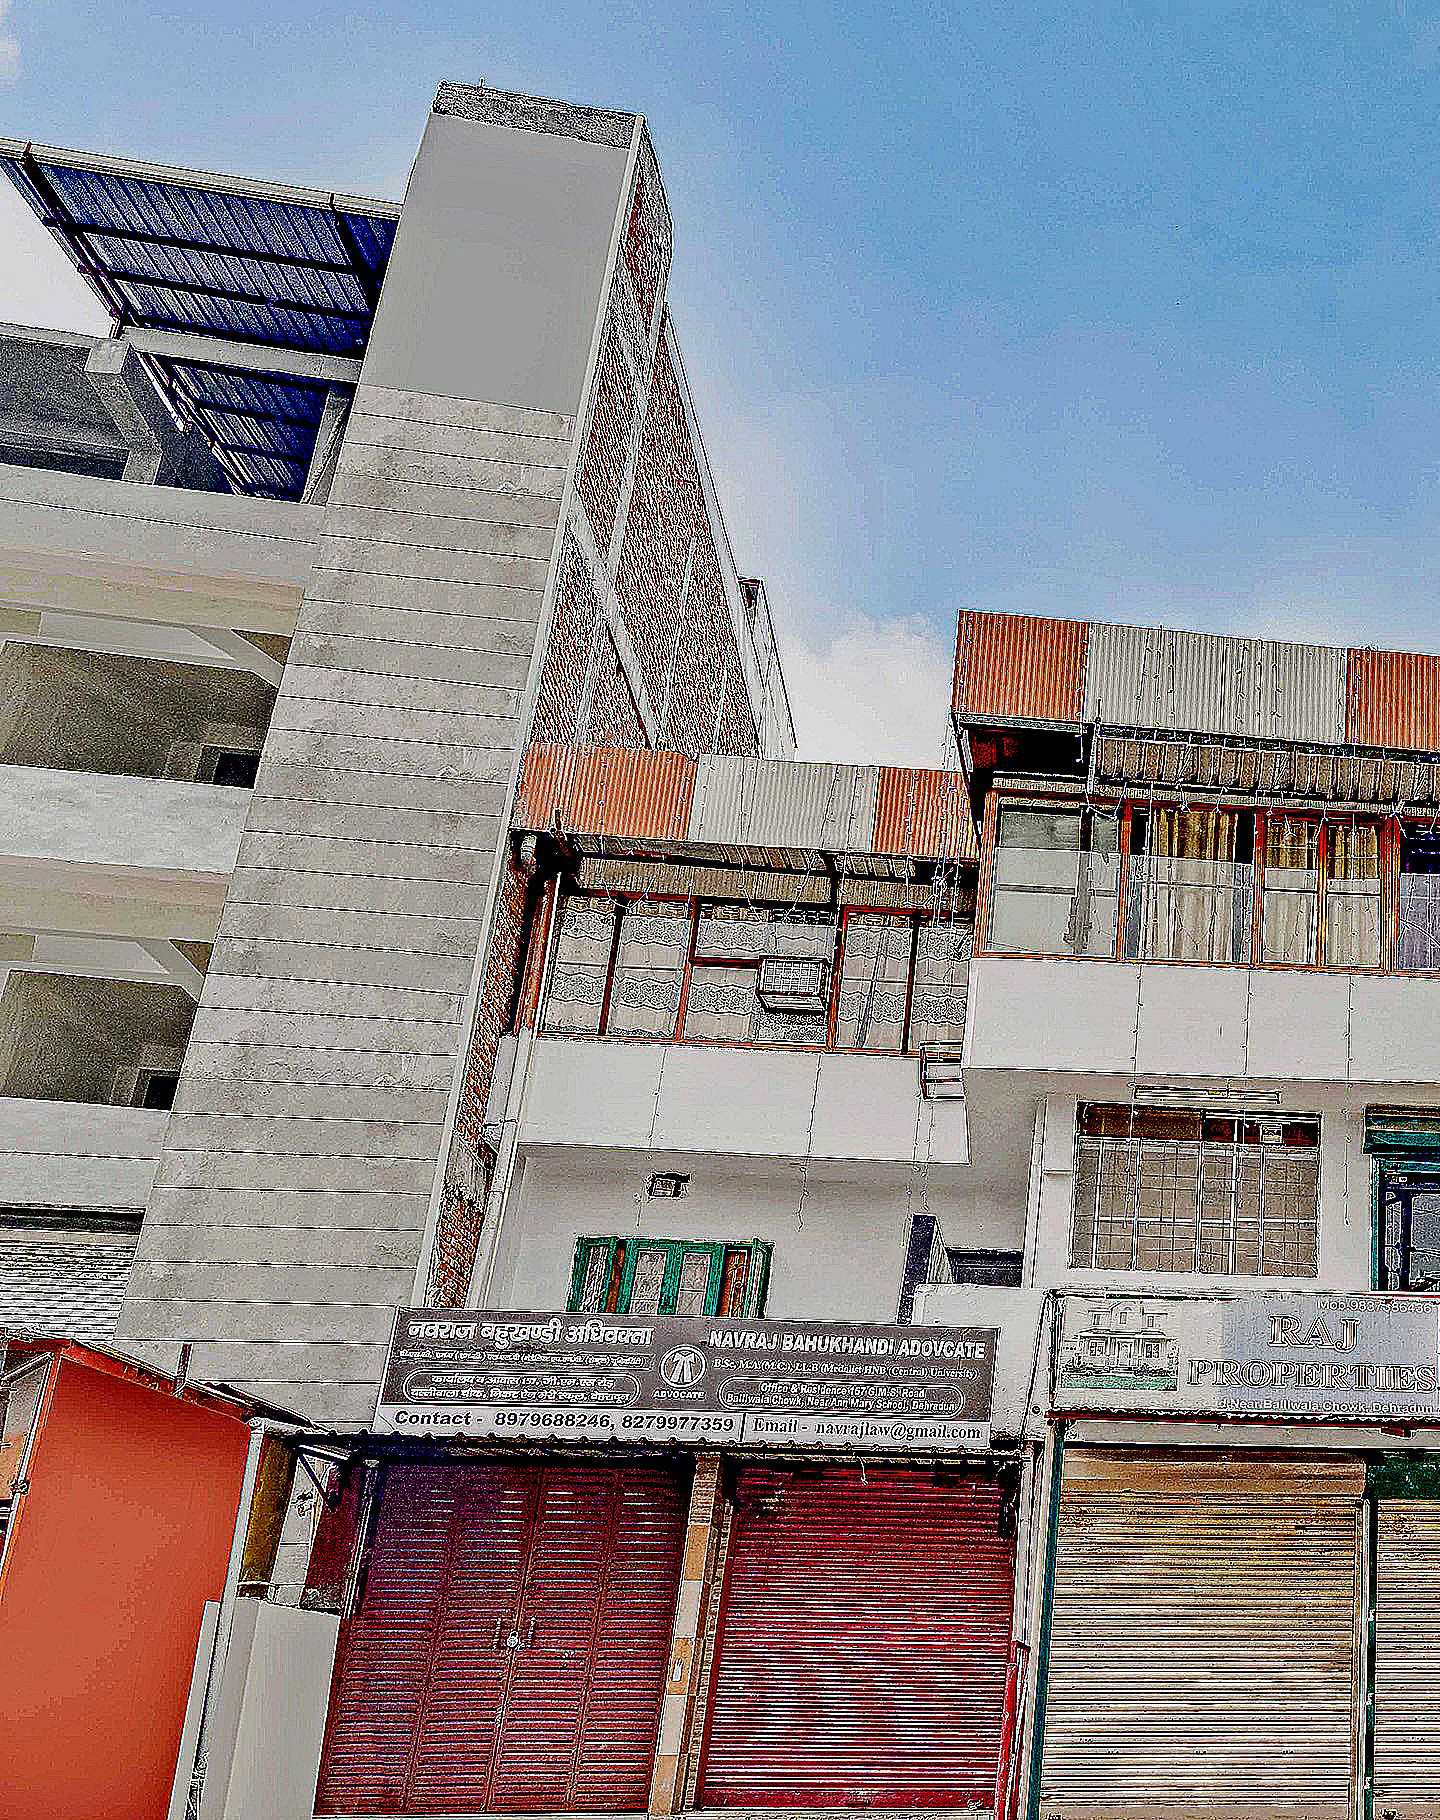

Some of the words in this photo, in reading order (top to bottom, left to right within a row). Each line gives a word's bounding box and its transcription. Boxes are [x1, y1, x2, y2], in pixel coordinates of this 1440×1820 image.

[408, 1320, 478, 1340] नवराज
[480, 1317, 562, 1349] बहुखण्डी
[709, 1330, 780, 1350] NAVRAJ
[782, 1334, 894, 1355] BAHUKHANDI
[899, 1339, 986, 1359] ADOVCATE
[1268, 1314, 1361, 1353] RAJ
[1187, 1359, 1437, 1393] PROPERTIES
[653, 1390, 706, 1401] ADVOCATE
[761, 1382, 789, 1394] Office
[902, 1387, 925, 1398] Road
[807, 1396, 829, 1407] Near
[850, 1398, 875, 1411] Mary
[911, 1401, 957, 1413] Dehradun
[1373, 1403, 1433, 1413] Dehradun
[395, 1409, 471, 1426] Contact
[494, 1411, 614, 1430] 8979688246,
[621, 1414, 734, 1432] 8279977359
[751, 1416, 798, 1433] Email
[814, 1420, 983, 1440] navrajlaw@gmail.com
